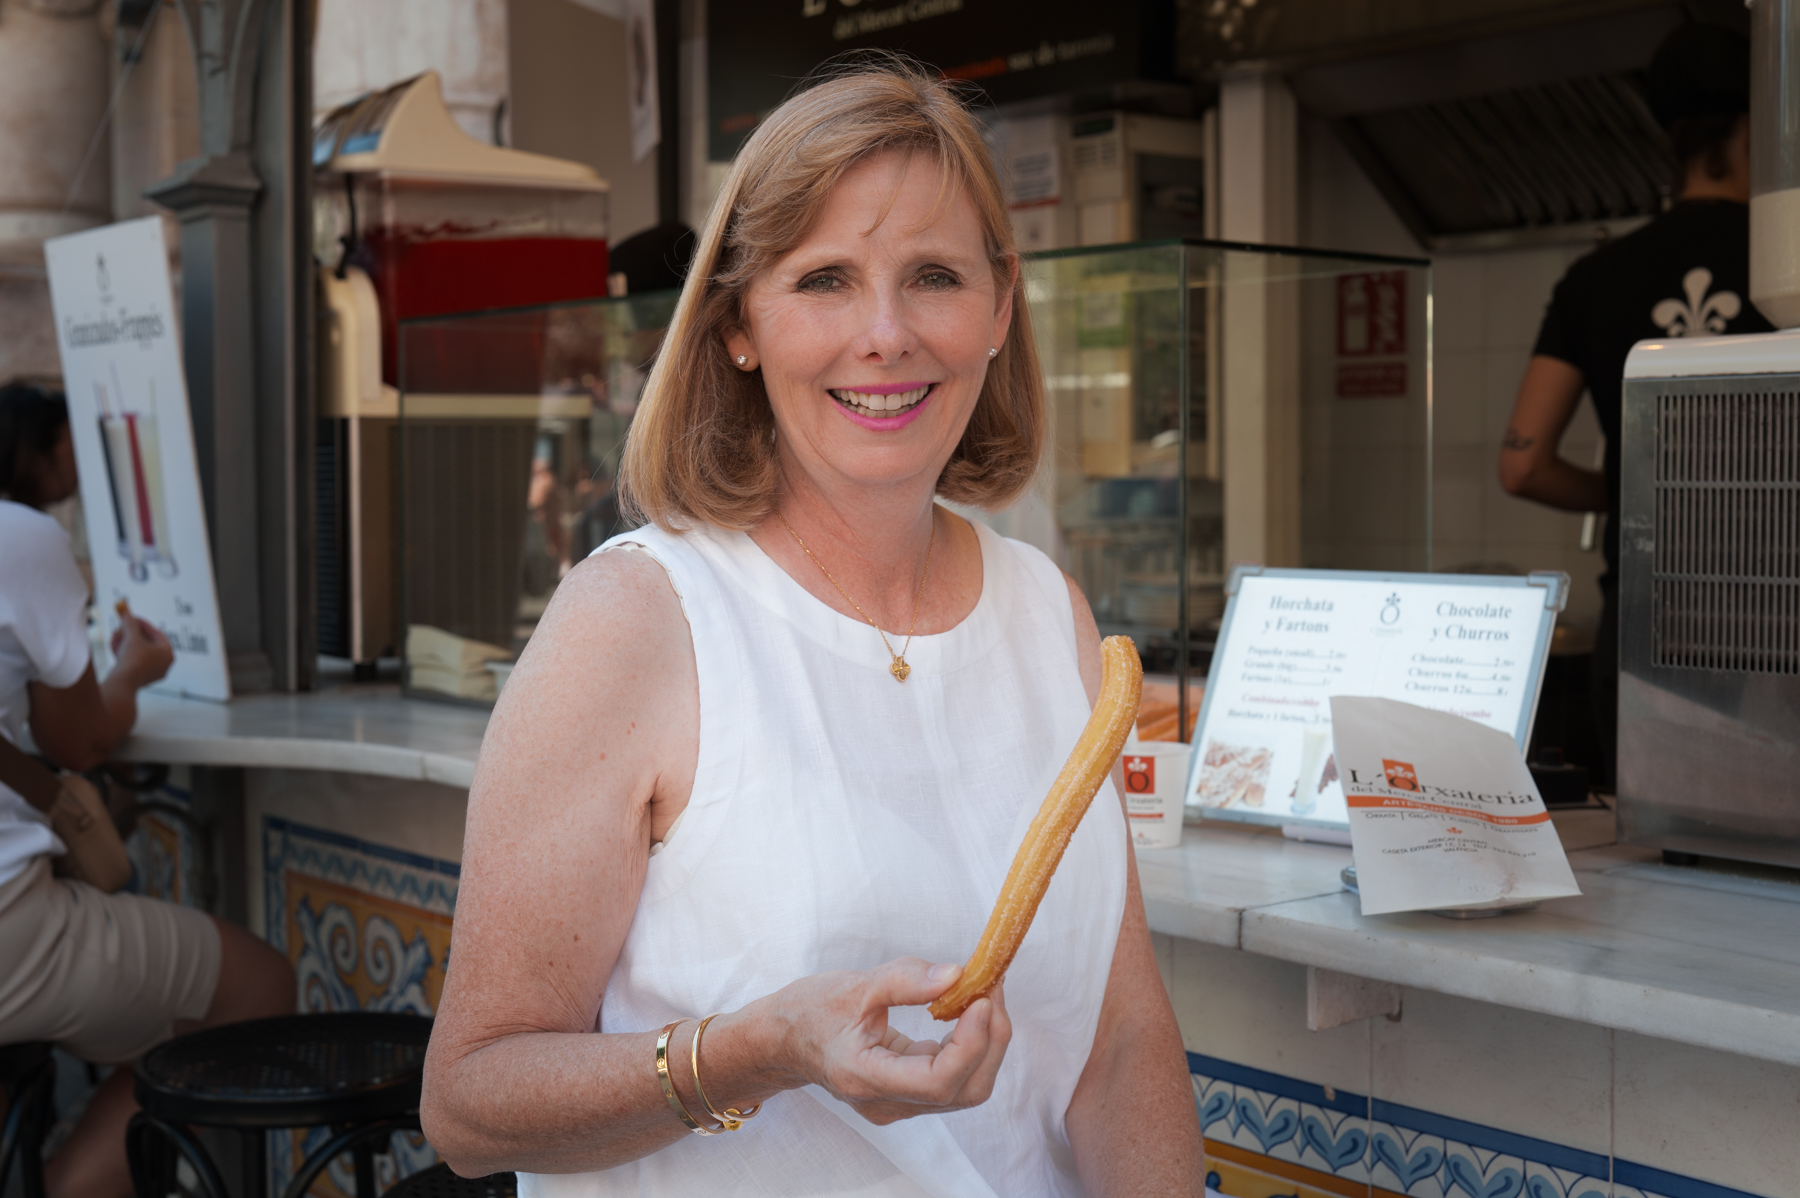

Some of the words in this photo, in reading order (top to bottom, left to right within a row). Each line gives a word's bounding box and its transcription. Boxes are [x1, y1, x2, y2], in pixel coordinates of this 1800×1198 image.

[1269, 595, 1334, 612] Horchata
[1436, 601, 1513, 618] Chocolate
[1262, 620, 1270, 634] y
[1276, 617, 1330, 633] Fartons
[1430, 626, 1438, 642] y
[1445, 623, 1509, 641] Churros
[1411, 654, 1465, 666] Chocolate
[1408, 667, 1452, 678] Churros
[1404, 681, 1449, 693] Churros
[1351, 785, 1373, 793] del
[1379, 787, 1426, 801] Mercat
[1431, 795, 1482, 810] Central
[1383, 799, 1446, 814] ARTESANS
[1449, 808, 1488, 821] DESDE
[1382, 847, 1409, 855] CASETA
[1410, 842, 1442, 853] EXTERIOR
